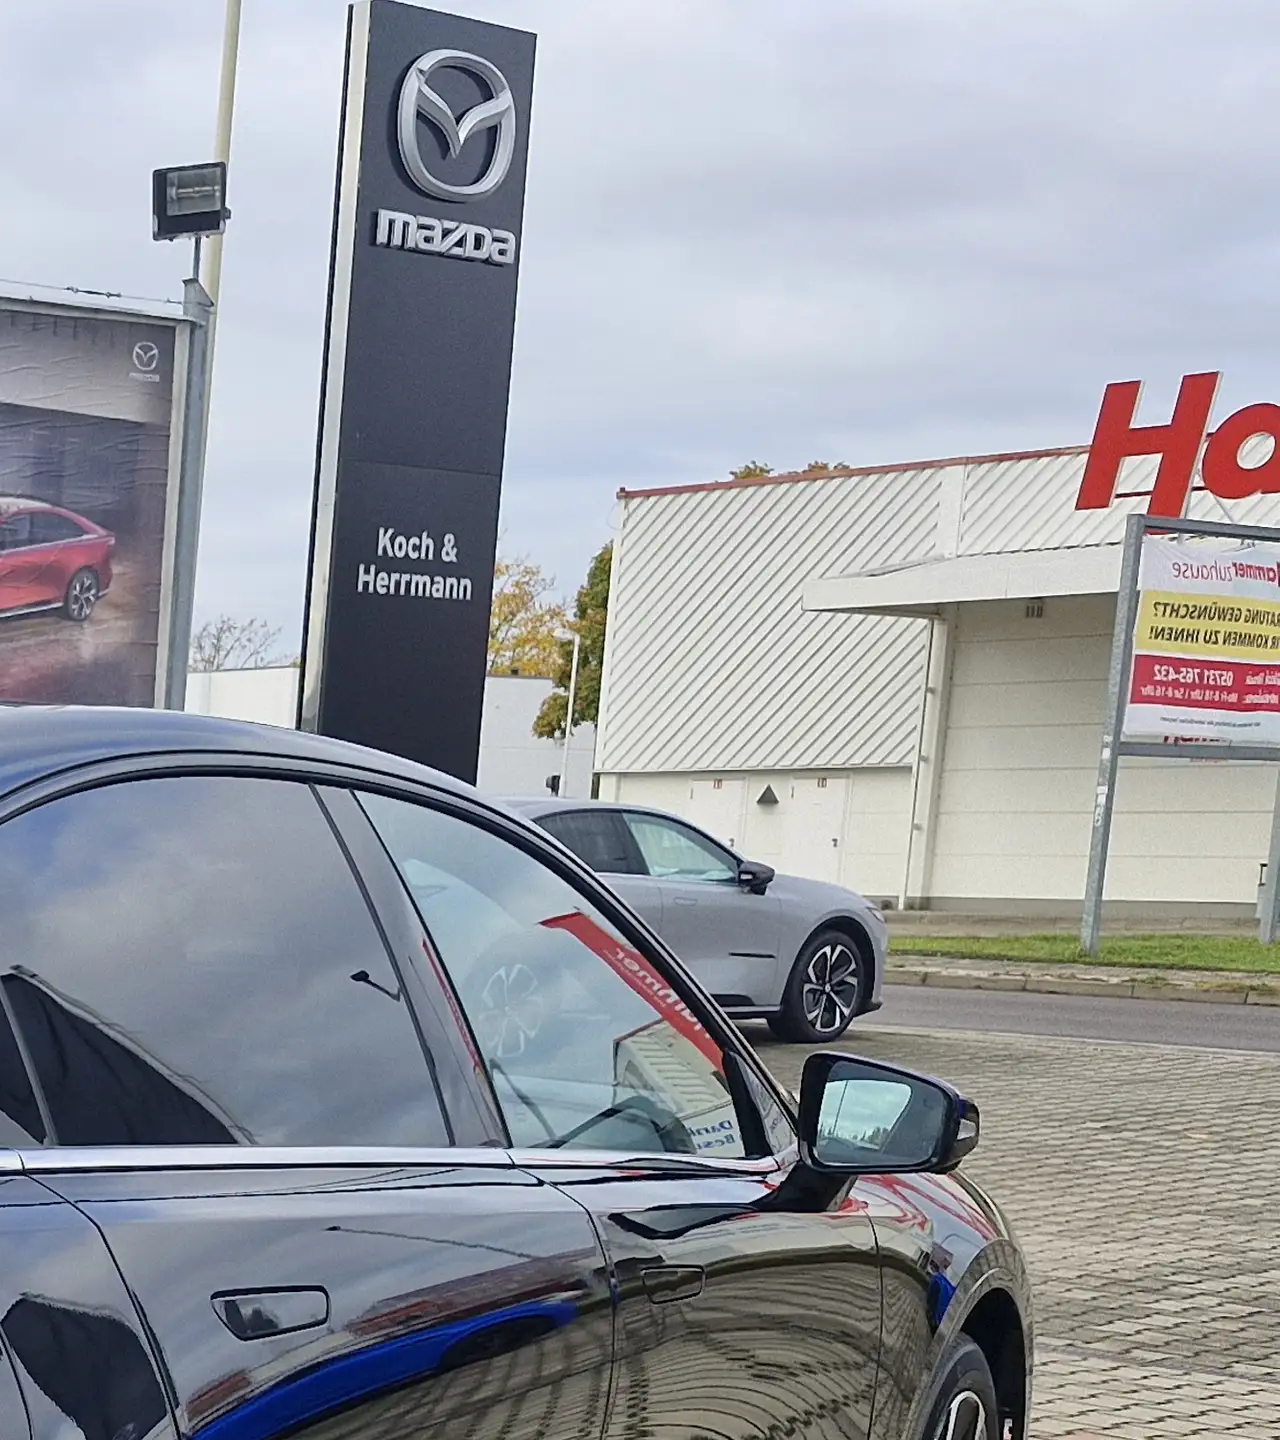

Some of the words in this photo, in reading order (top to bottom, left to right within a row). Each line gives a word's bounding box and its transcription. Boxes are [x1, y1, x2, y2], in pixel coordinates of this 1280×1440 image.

[376, 208, 516, 264] mazda
[377, 527, 434, 560] Koch
[441, 533, 458, 562] &
[357, 563, 472, 600] Herrmann
